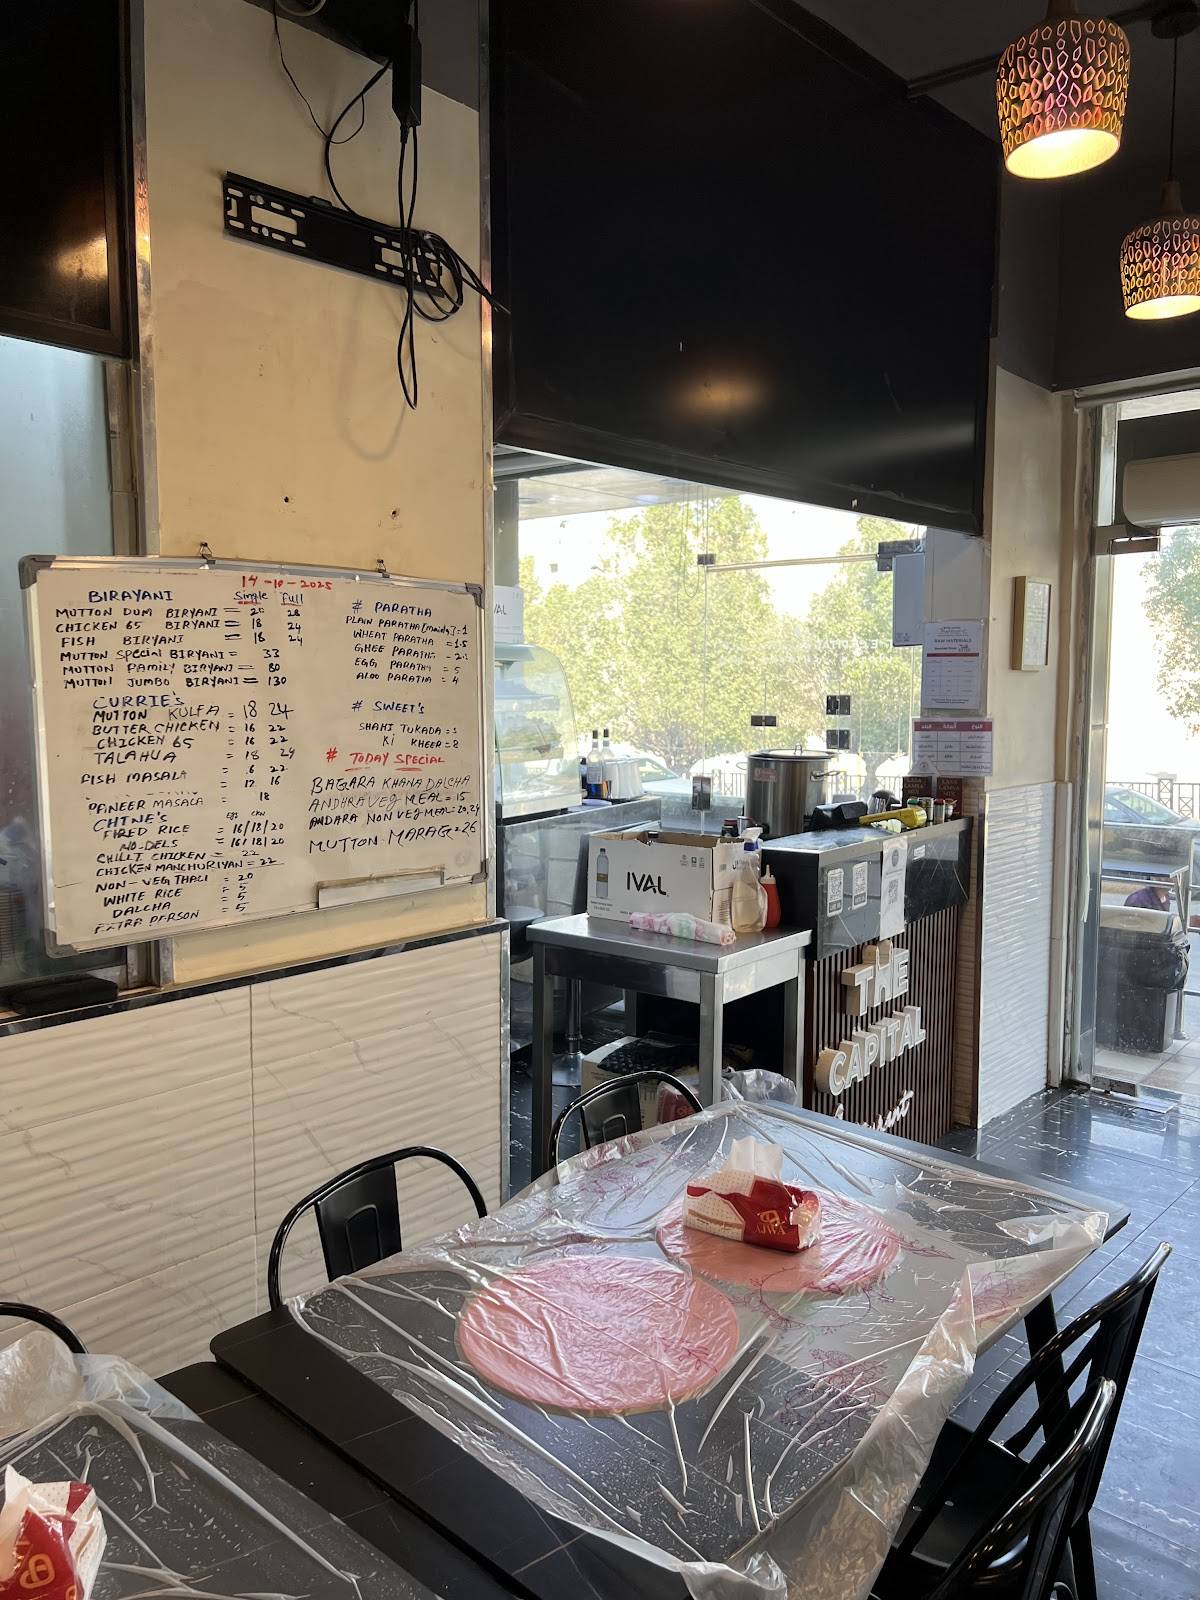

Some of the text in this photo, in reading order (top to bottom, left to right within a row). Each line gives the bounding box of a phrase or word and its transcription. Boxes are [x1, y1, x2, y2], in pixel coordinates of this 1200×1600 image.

[88, 589, 174, 603] BIRAYANI
[56, 608, 113, 618] MUTTON
[123, 607, 153, 617] DUM
[166, 608, 217, 618] BIRYANI
[375, 601, 432, 617] PARATHA
[56, 621, 117, 633] CHICKEN
[126, 621, 142, 630] 65
[165, 620, 220, 630] BIRYANI
[252, 618, 262, 629] 18
[287, 622, 301, 634] 24
[345, 615, 373, 625] PLAIN
[61, 636, 96, 648] FISH
[123, 634, 185, 646] BIRYANI
[254, 631, 266, 644] 18
[288, 635, 303, 647] 24
[353, 629, 386, 640] WHEAT
[393, 632, 434, 646] PARATHA
[354, 643, 385, 653] GHEE
[60, 650, 108, 662] MUTTON
[170, 649, 224, 661] BIRYANI
[262, 649, 280, 659] 33
[354, 657, 378, 668] EGG
[63, 664, 114, 676] MUTTON
[184, 663, 233, 674] BIRYANI
[268, 662, 281, 673] 80
[64, 677, 113, 689] MUTTON
[127, 678, 170, 687] JUMBO
[186, 677, 239, 688] BIRYANI
[268, 676, 287, 686] 130
[93, 708, 148, 723] MUTTON
[168, 704, 220, 720] KULFA
[243, 700, 258, 719] 18
[269, 702, 295, 720] 24
[92, 724, 152, 735] BUTTER
[154, 720, 220, 734] CHICKEN
[245, 723, 256, 732] 16
[268, 724, 286, 732] 22
[400, 723, 442, 735] TUKADA
[97, 735, 289, 750] CHICKEN 65 16 22
[411, 738, 441, 749] KHEER
[245, 750, 260, 760] 18
[350, 752, 389, 766] TODAY
[81, 773, 116, 785] FISH
[126, 770, 187, 783] MASALA
[270, 776, 281, 786] 16
[310, 774, 471, 796] BAGARA KHANA DALCHA
[260, 792, 270, 801] 18
[308, 796, 366, 812] ANDHRA
[405, 792, 443, 806] MEAL
[456, 791, 470, 802] 15
[367, 811, 392, 825] NON
[158, 825, 190, 835] RICE
[309, 835, 378, 854] MUTTON
[151, 852, 206, 861] CHICKEN
[96, 863, 151, 877] CHICKEN
[155, 860, 243, 872] MANCHURIYAN
[260, 857, 277, 866] 22
[238, 873, 254, 881] 20
[627, 871, 667, 896] IVAL
[104, 891, 145, 907] WHITE
[155, 888, 183, 899] RICE
[113, 901, 171, 919] DALCHA
[846, 940, 909, 1016] THE
[822, 1005, 927, 1096] CAPITAL
